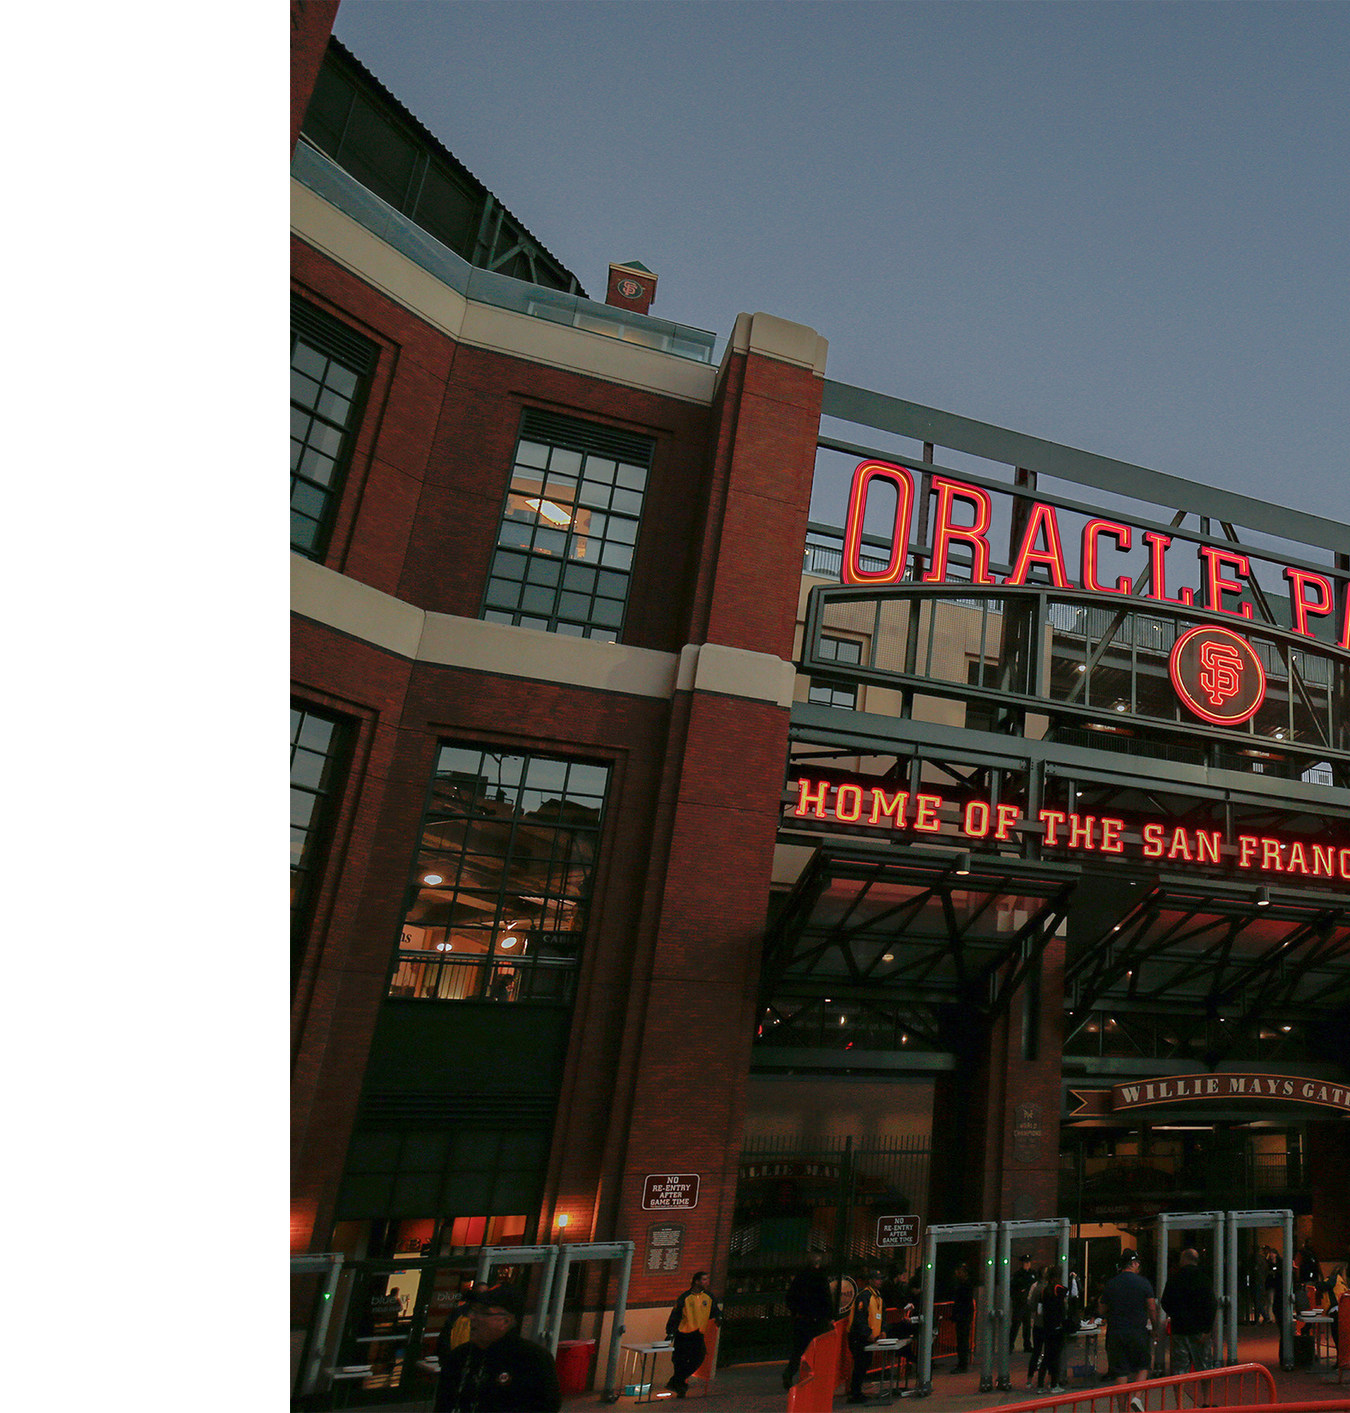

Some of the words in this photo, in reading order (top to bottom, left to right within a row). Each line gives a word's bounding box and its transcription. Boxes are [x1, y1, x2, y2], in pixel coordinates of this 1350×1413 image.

[840, 459, 1254, 620] ORACLE
[795, 777, 942, 832] HOME
[964, 800, 1020, 840] OF
[1039, 809, 1125, 854] THE
[1142, 822, 1222, 864] SAN
[1121, 1078, 1220, 1104] WILLIE
[1228, 1078, 1295, 1097] MAYS
[666, 1176, 679, 1184] NO
[652, 1184, 691, 1192] RE-ENTRY
[659, 1191, 682, 1199] AFTER
[650, 1198, 670, 1206] GAME
